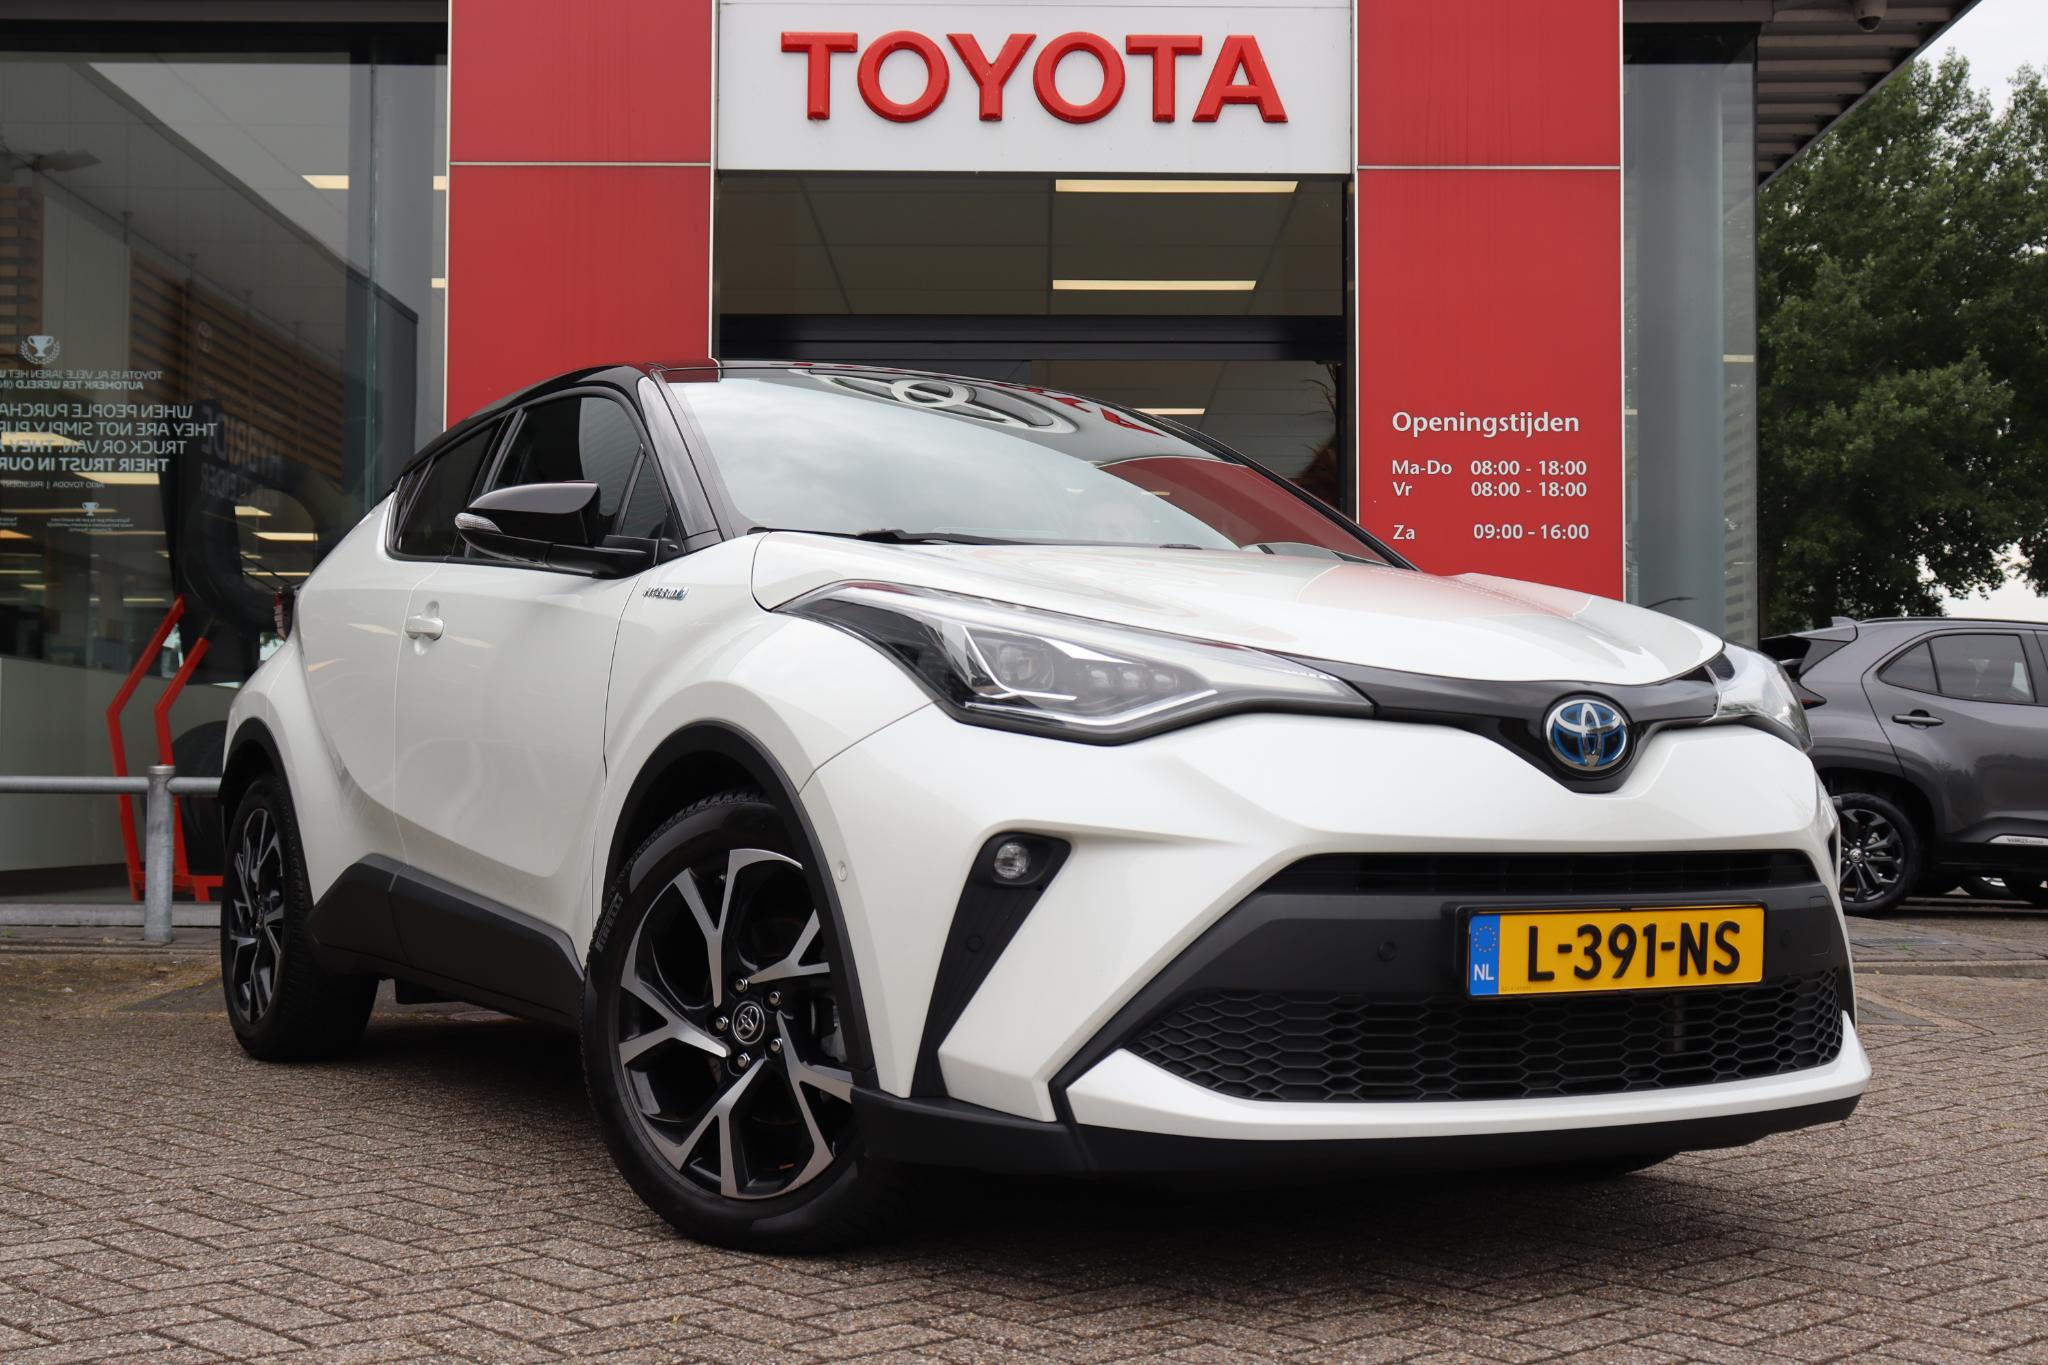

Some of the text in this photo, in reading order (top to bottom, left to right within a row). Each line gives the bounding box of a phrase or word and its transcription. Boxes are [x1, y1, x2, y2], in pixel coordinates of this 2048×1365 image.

[780, 30, 1289, 125] TOYOTA
[1392, 412, 1579, 438] Openingstijden
[1392, 460, 1452, 474] Ma-Do
[1470, 460, 1520, 475] 08:00
[1539, 460, 1587, 475] 18:00
[1393, 482, 1412, 496] Vr
[1471, 482, 1520, 497] 08:00
[1539, 482, 1587, 497] 18:00
[1393, 525, 1415, 539] Za
[1473, 524, 1523, 539] 09:00
[1540, 524, 1589, 539] 16:00
[1474, 920, 1741, 982] NL L-391-NS
